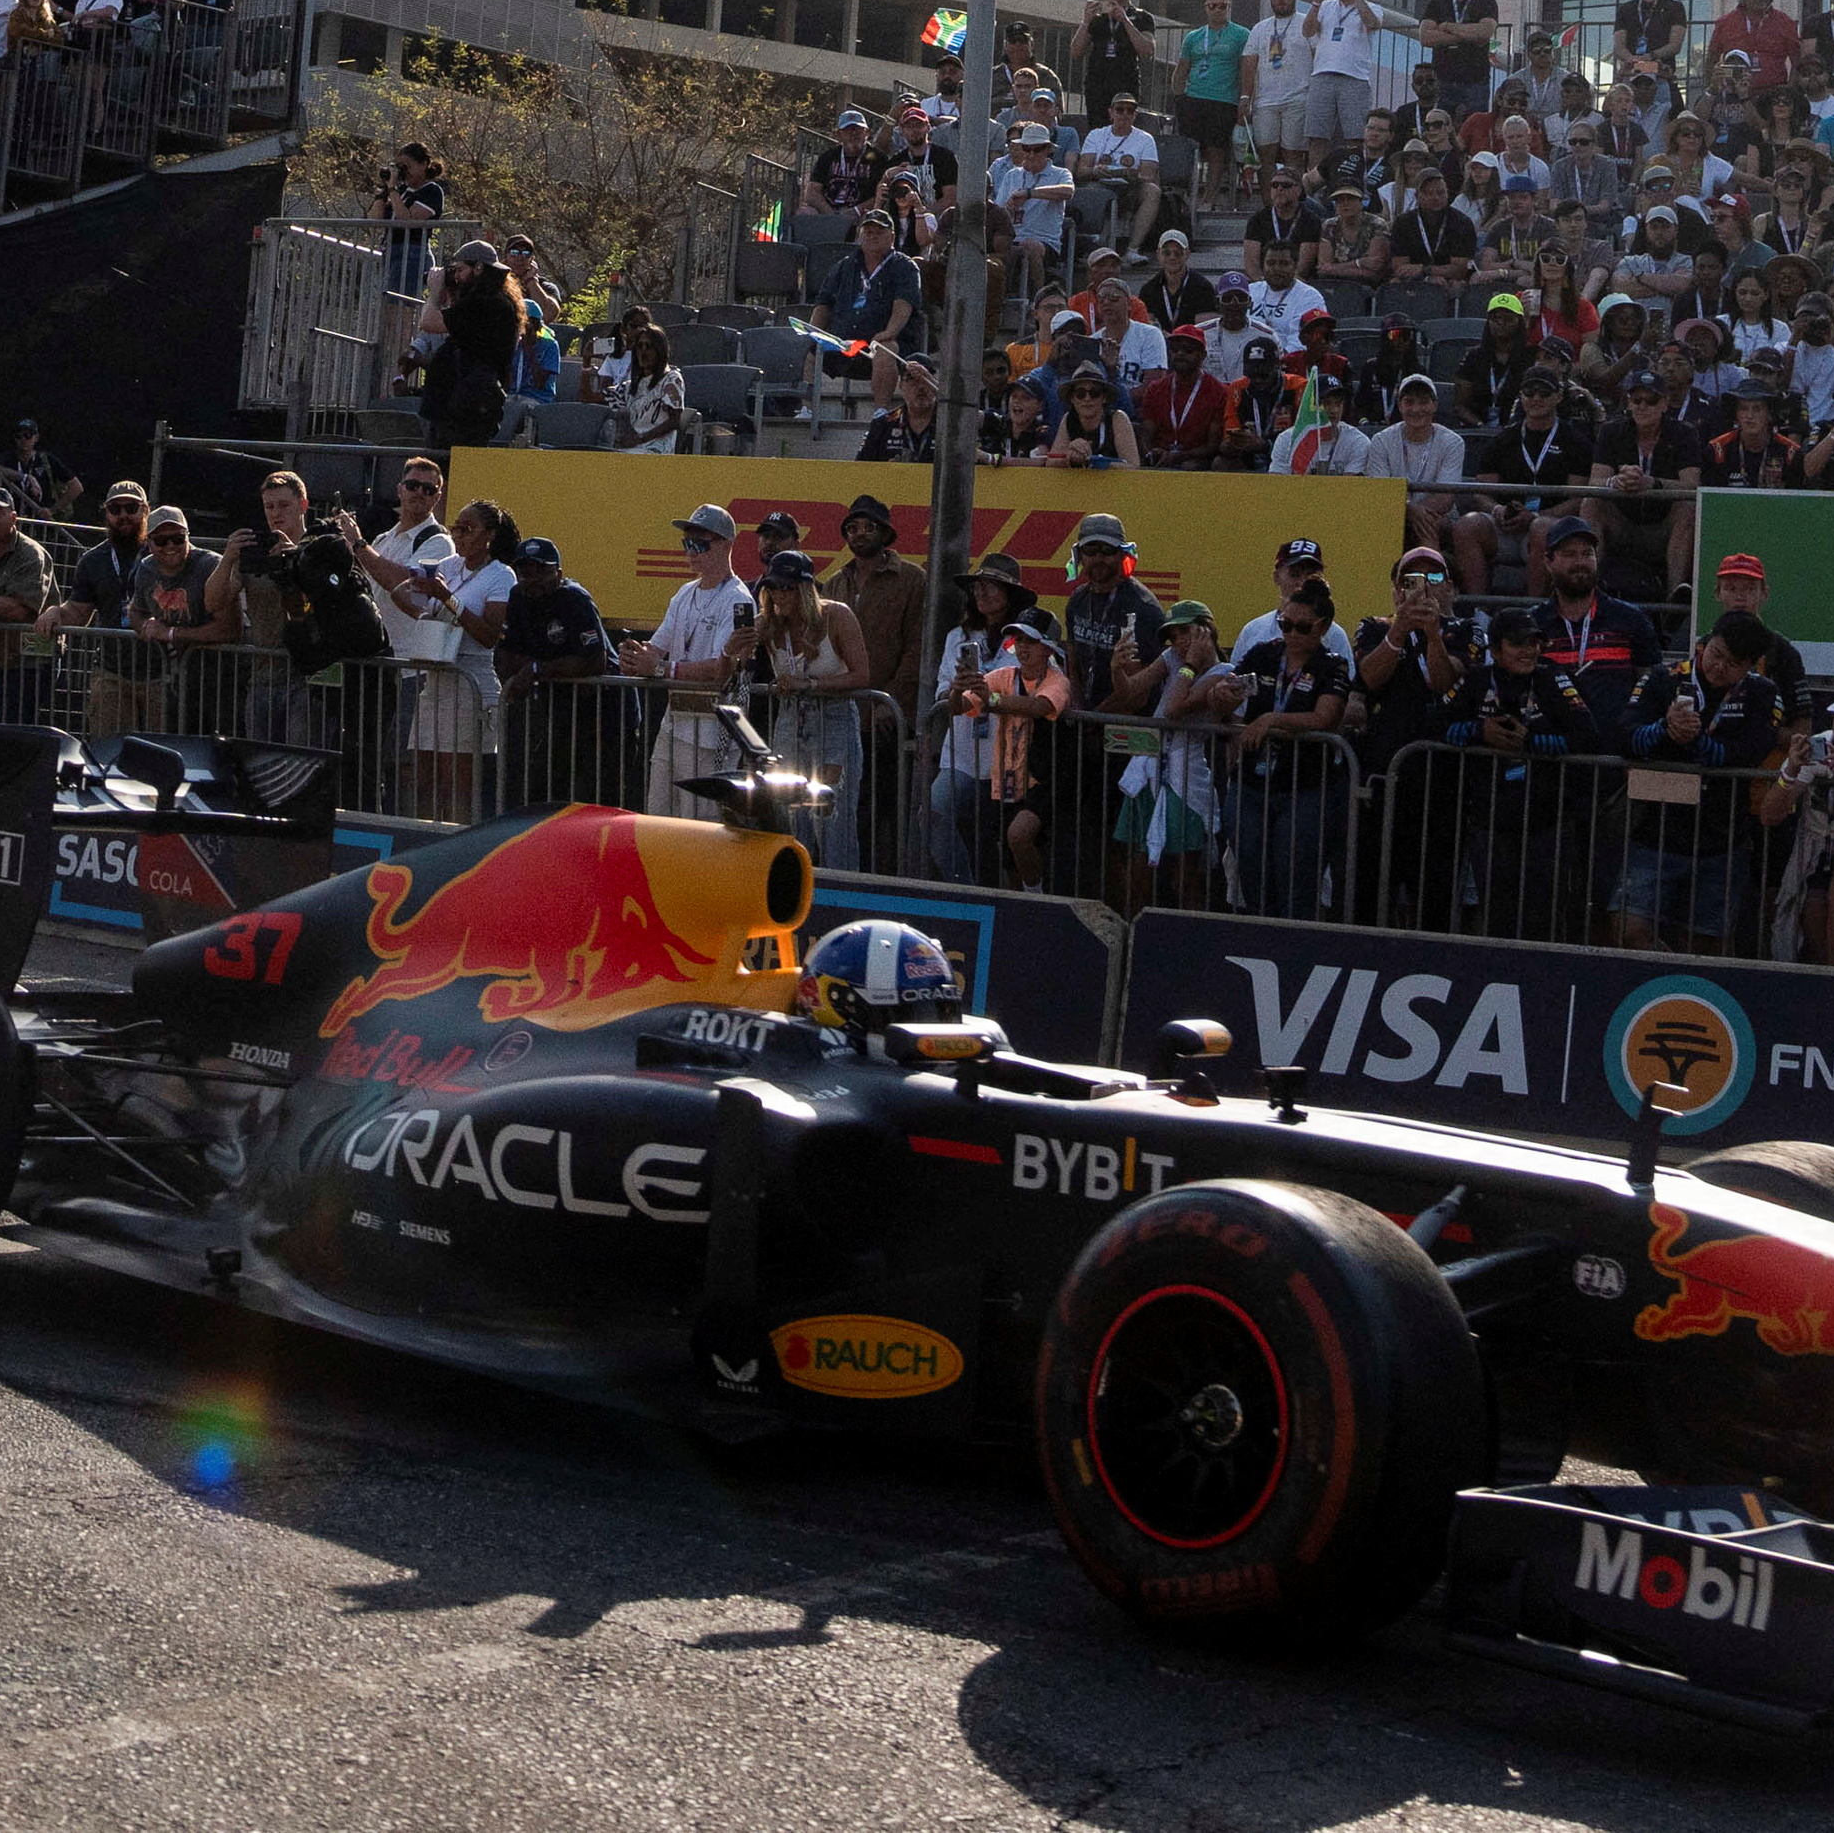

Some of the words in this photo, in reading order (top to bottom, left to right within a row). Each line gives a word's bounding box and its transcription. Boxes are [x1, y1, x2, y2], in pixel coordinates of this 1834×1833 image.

[1289, 539, 1317, 554] 93
[0, 836, 11, 879] 1
[149, 870, 194, 896] COLA
[204, 911, 303, 985] 37
[902, 986, 964, 1003] ORACLE
[682, 1010, 777, 1052] ROKT
[1224, 955, 1529, 1094] VISA
[228, 1042, 291, 1069] HONDA
[322, 1026, 399, 1078] Red
[345, 1108, 711, 1223] ORACLE
[1013, 1132, 1175, 1201] BYBIT
[398, 1220, 451, 1246] SIEMENS
[1576, 1261, 1619, 1292] FIA
[814, 1338, 938, 1377] RAUCH
[1574, 1520, 1774, 1631] Mobil
